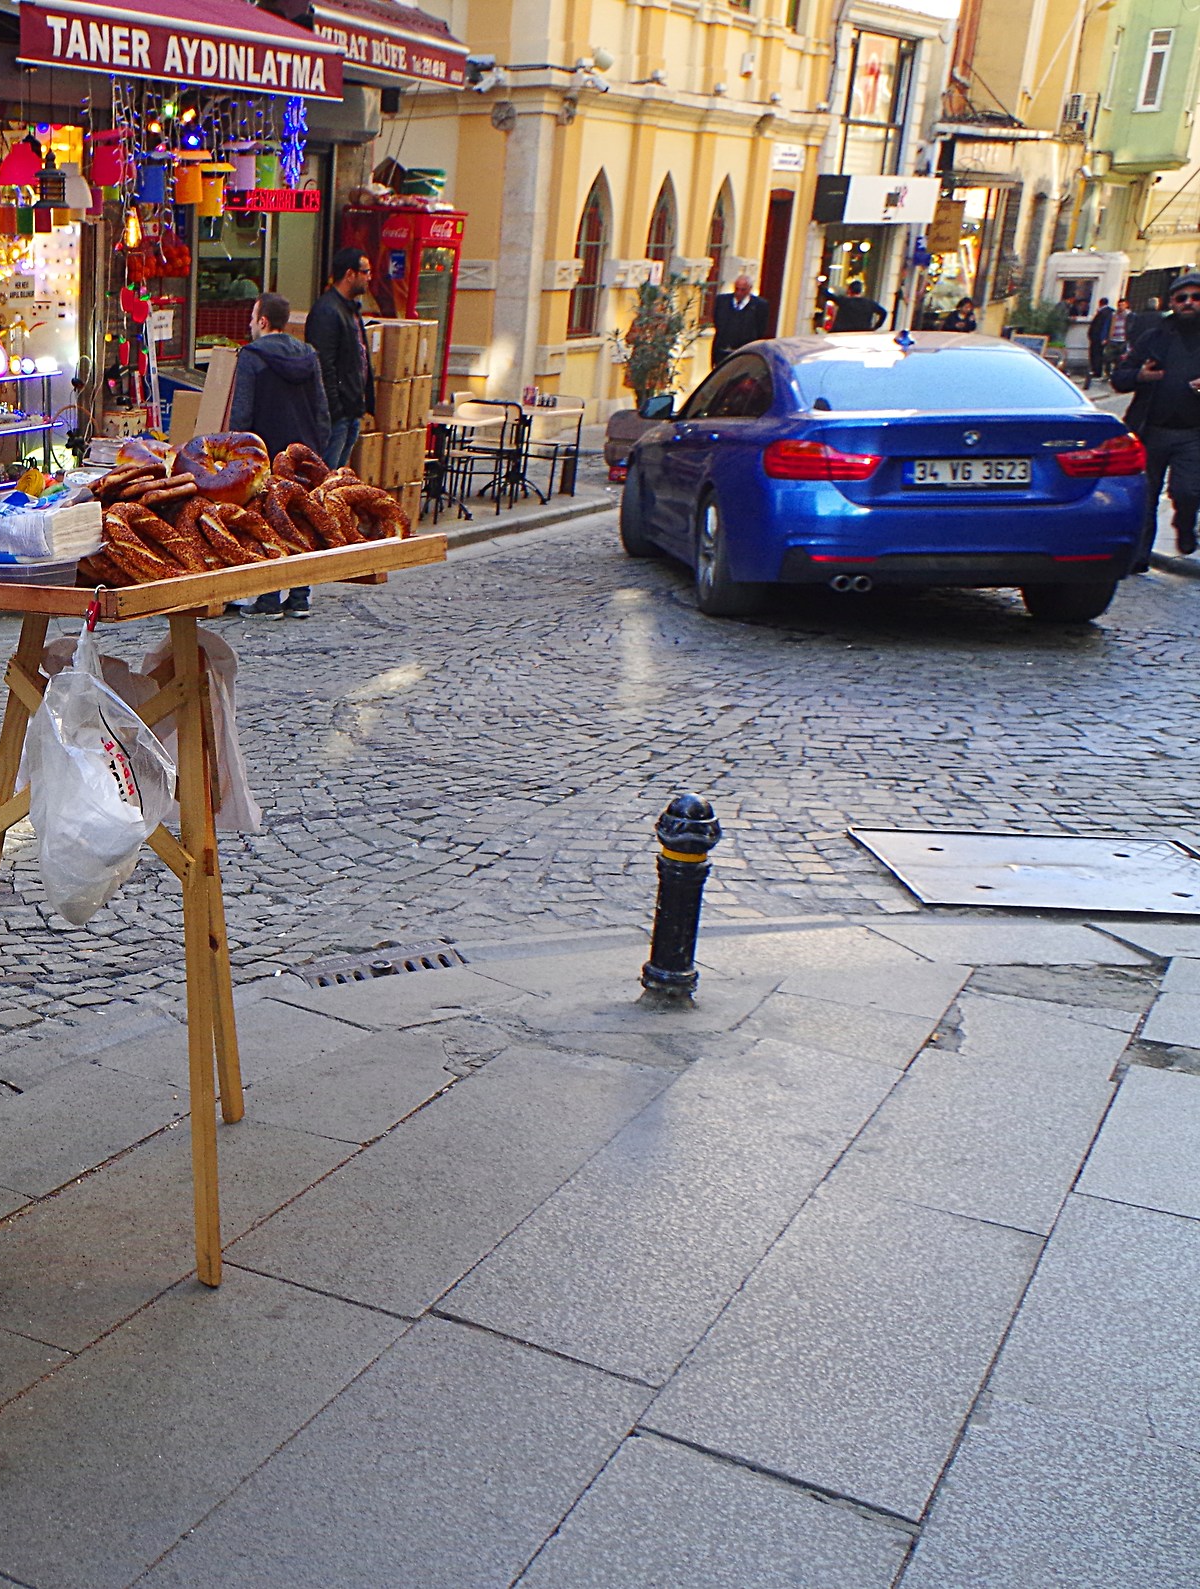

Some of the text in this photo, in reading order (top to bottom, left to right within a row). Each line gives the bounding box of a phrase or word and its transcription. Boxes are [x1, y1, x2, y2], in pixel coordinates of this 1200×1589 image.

[46, 15, 326, 93] TANER AYDINLATMA
[371, 37, 408, 71] BÜFE
[916, 461, 1029, 481] 34 VG 3623
